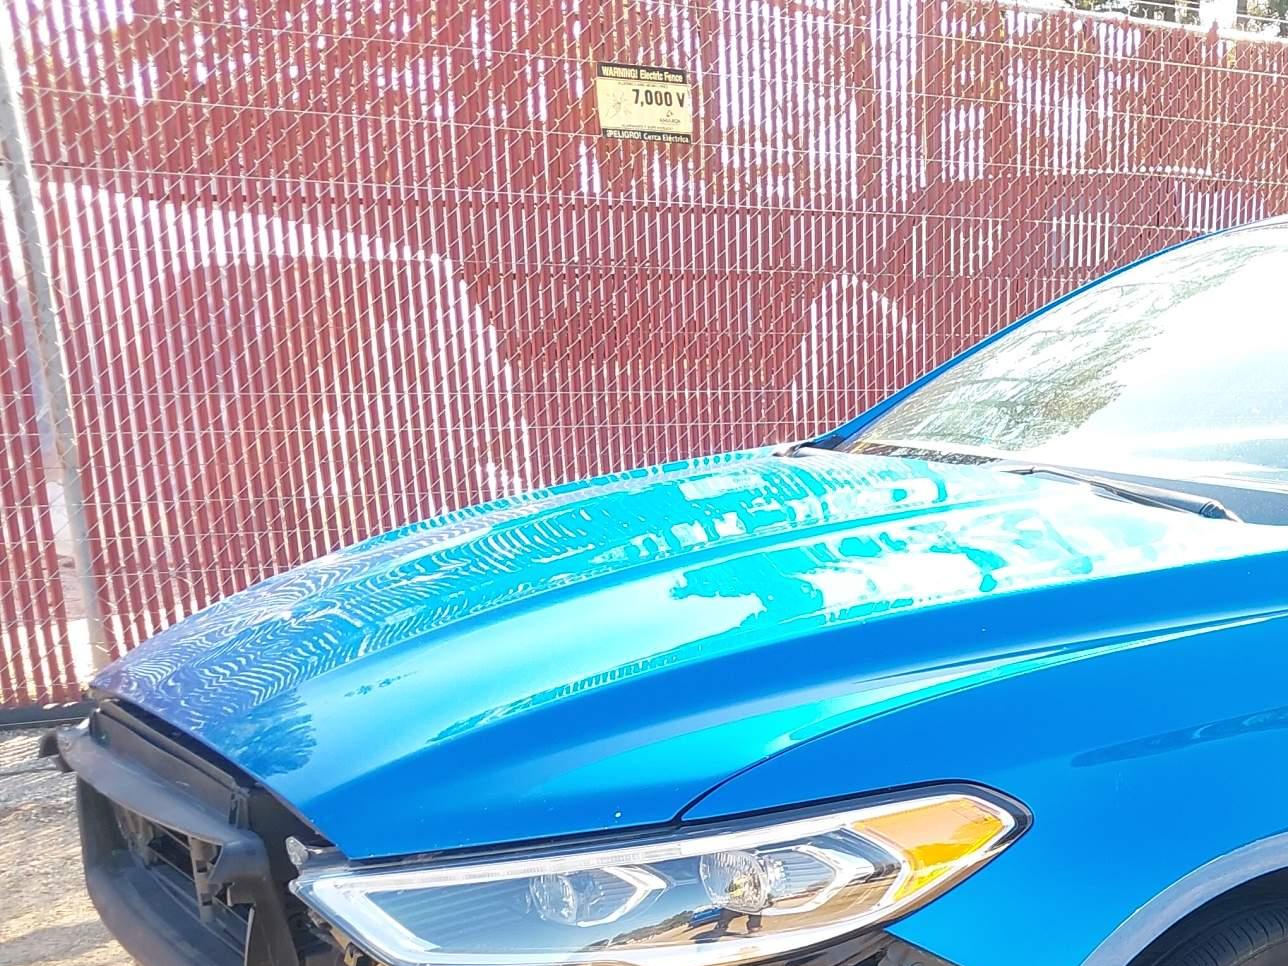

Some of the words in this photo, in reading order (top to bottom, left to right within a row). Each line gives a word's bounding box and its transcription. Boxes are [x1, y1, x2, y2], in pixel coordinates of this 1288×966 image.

[601, 66, 638, 78] WARNING!
[640, 70, 663, 81] Electric
[664, 71, 683, 83] Fence
[632, 88, 673, 107] 7,000
[676, 92, 685, 107] V
[606, 129, 642, 140] ¡PELIGRO!
[643, 132, 662, 141] Cerca
[662, 133, 689, 143] Eléctrica
